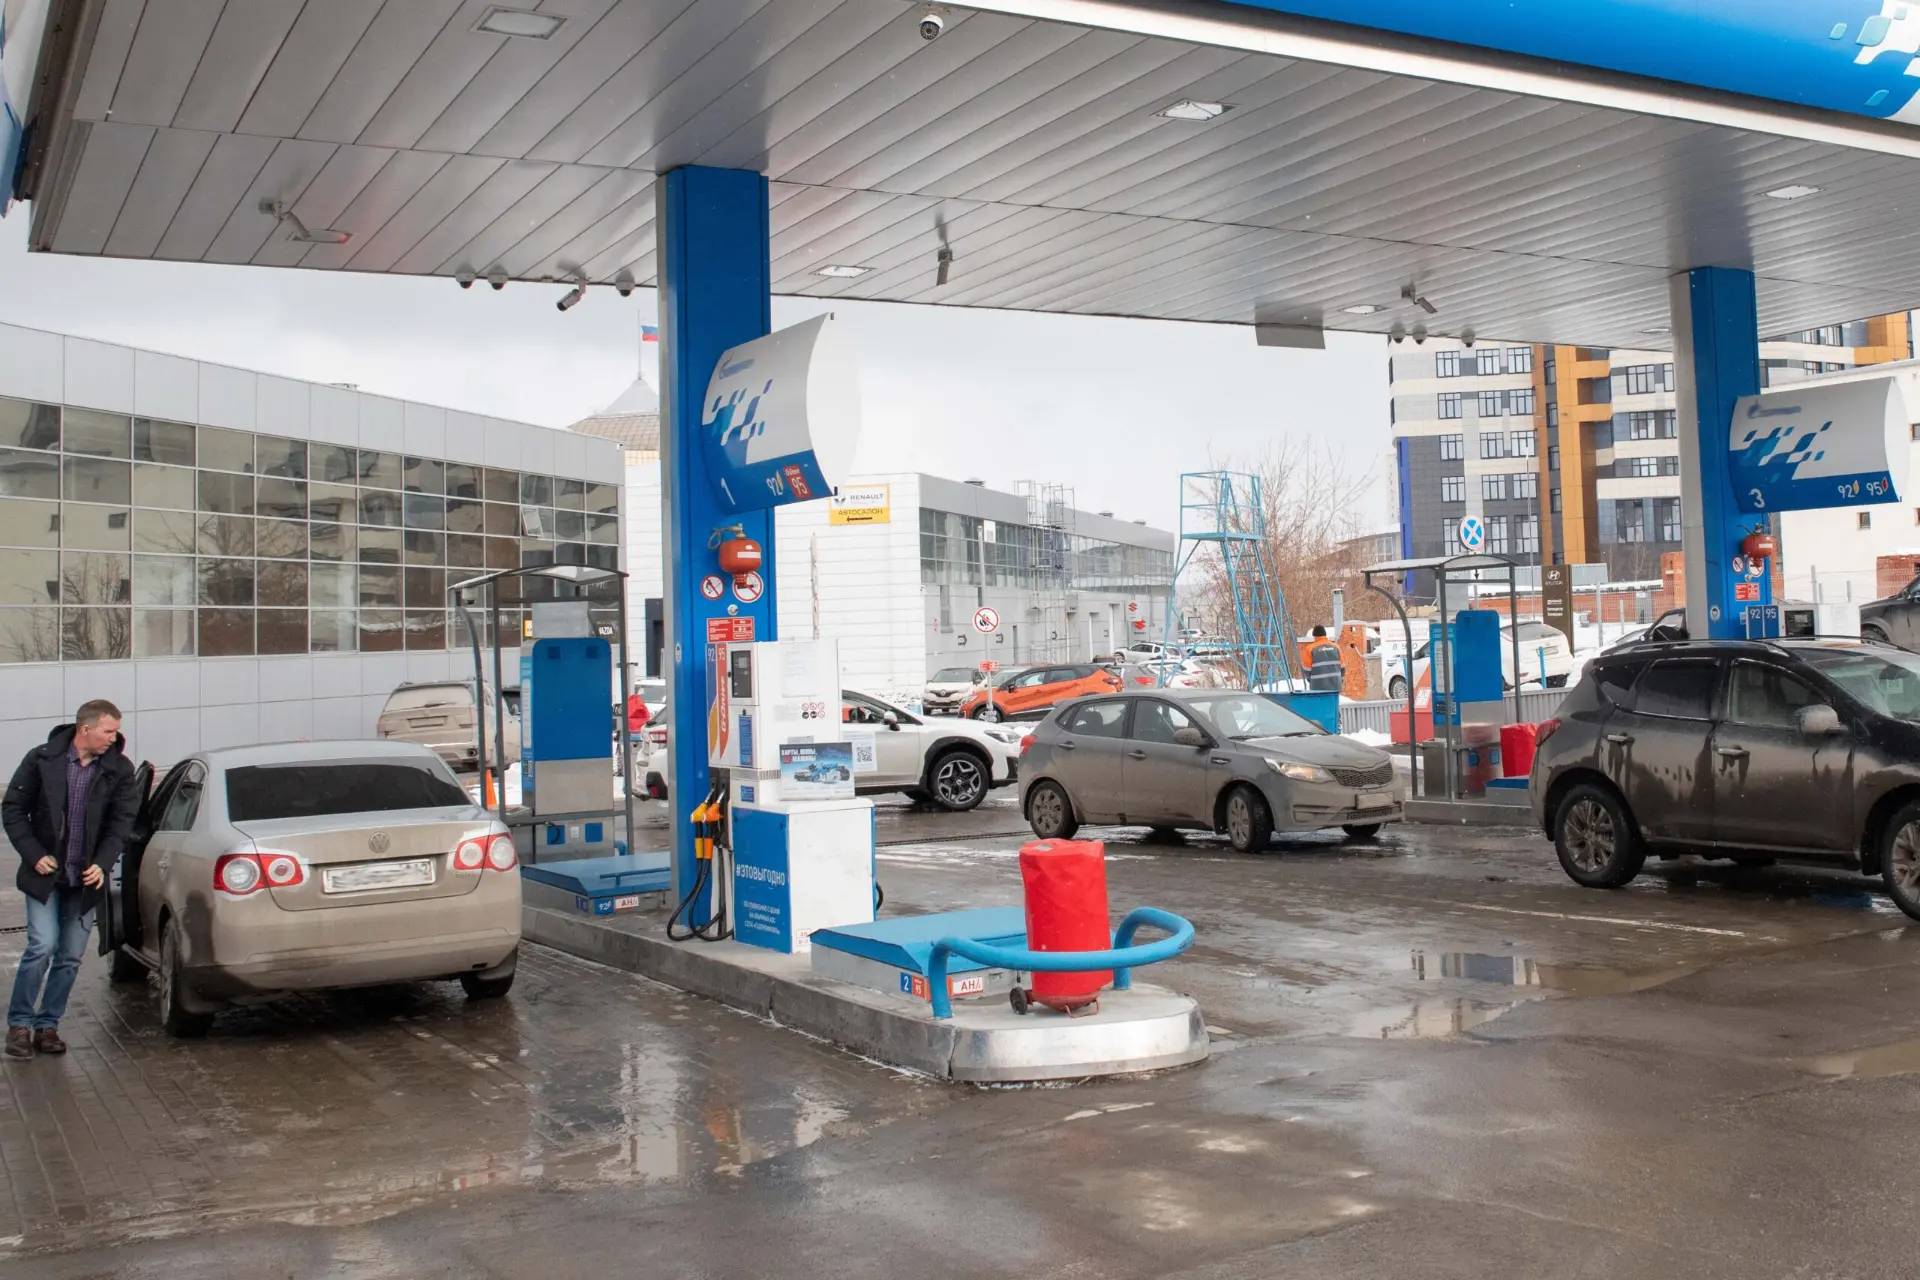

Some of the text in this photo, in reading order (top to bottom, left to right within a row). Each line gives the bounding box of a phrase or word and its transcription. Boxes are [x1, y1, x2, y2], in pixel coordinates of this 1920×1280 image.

[721, 477, 736, 506] 1
[766, 477, 783, 496] 92
[791, 477, 808, 496] 95
[1838, 485, 1855, 498] 92
[1866, 481, 1883, 496] 95
[850, 493, 884, 501] RENAULT
[1749, 488, 1765, 509] 3
[838, 508, 883, 516] АВТОСАЛОН
[1750, 608, 1761, 619] 92
[1766, 608, 1777, 619] 95
[736, 863, 786, 887] #ЭТОВЫГОДНО
[904, 975, 909, 991] 2
